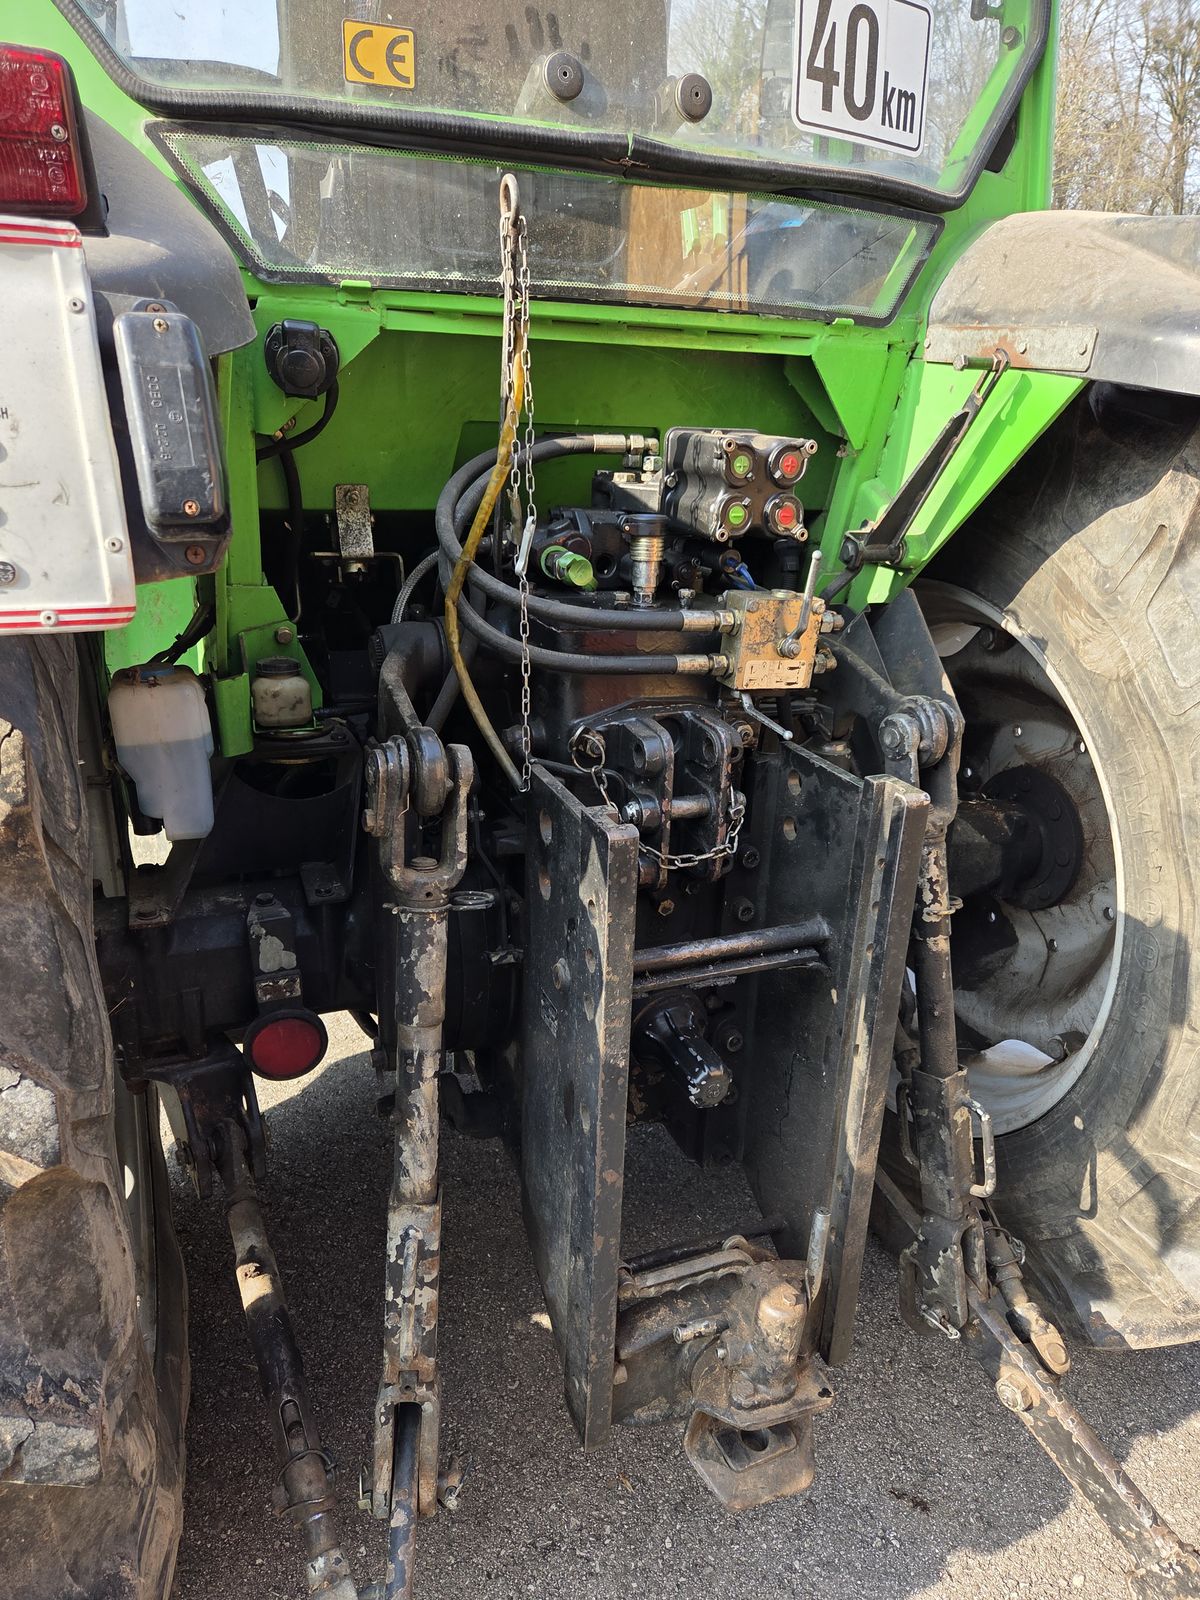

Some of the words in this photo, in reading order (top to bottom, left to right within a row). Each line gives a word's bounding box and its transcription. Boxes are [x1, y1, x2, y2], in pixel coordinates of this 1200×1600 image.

[349, 29, 410, 84] CE
[806, 0, 879, 121] 40
[881, 71, 916, 134] km
